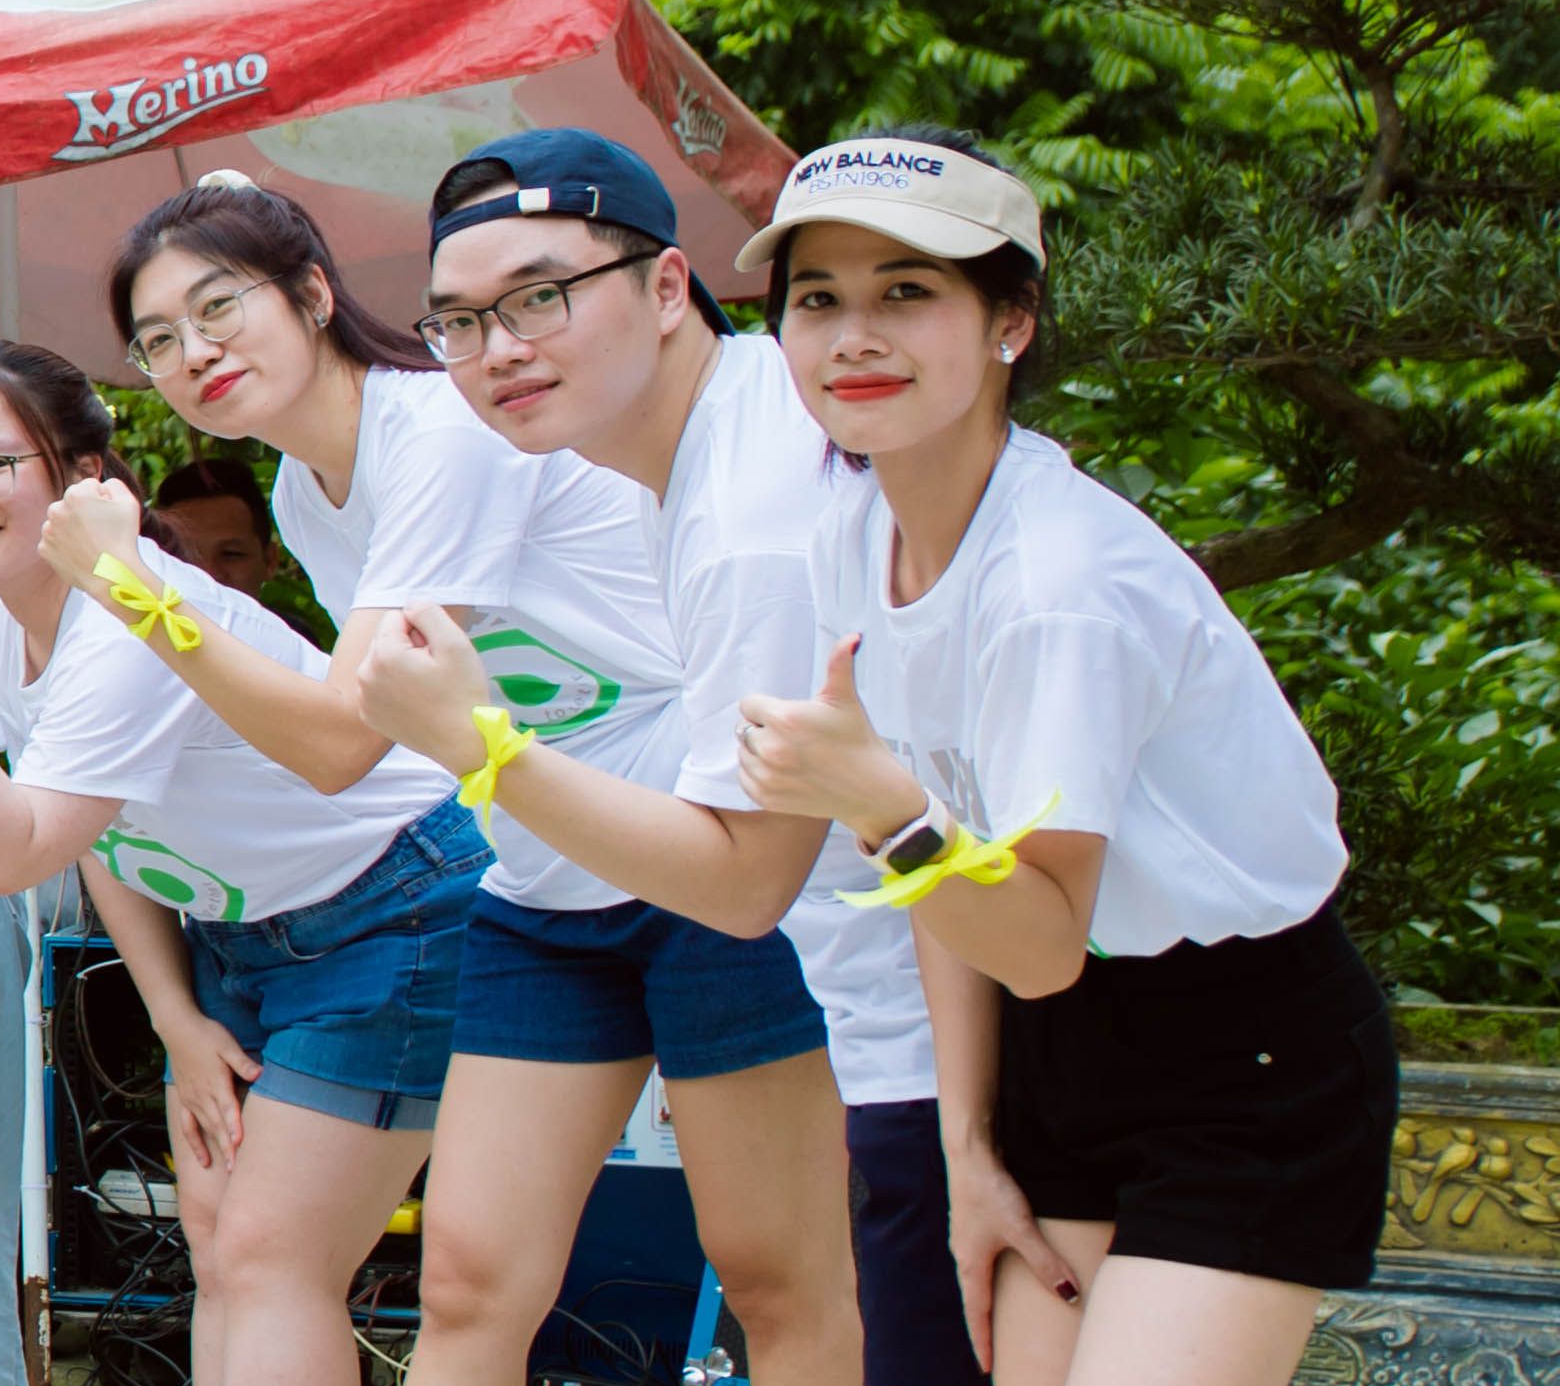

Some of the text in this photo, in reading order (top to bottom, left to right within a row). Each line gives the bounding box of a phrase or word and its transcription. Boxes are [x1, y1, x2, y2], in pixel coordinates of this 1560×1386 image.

[58, 53, 269, 159] Merino
[794, 151, 945, 187] NEW BALANCE
[808, 170, 911, 194] BSTN1906
